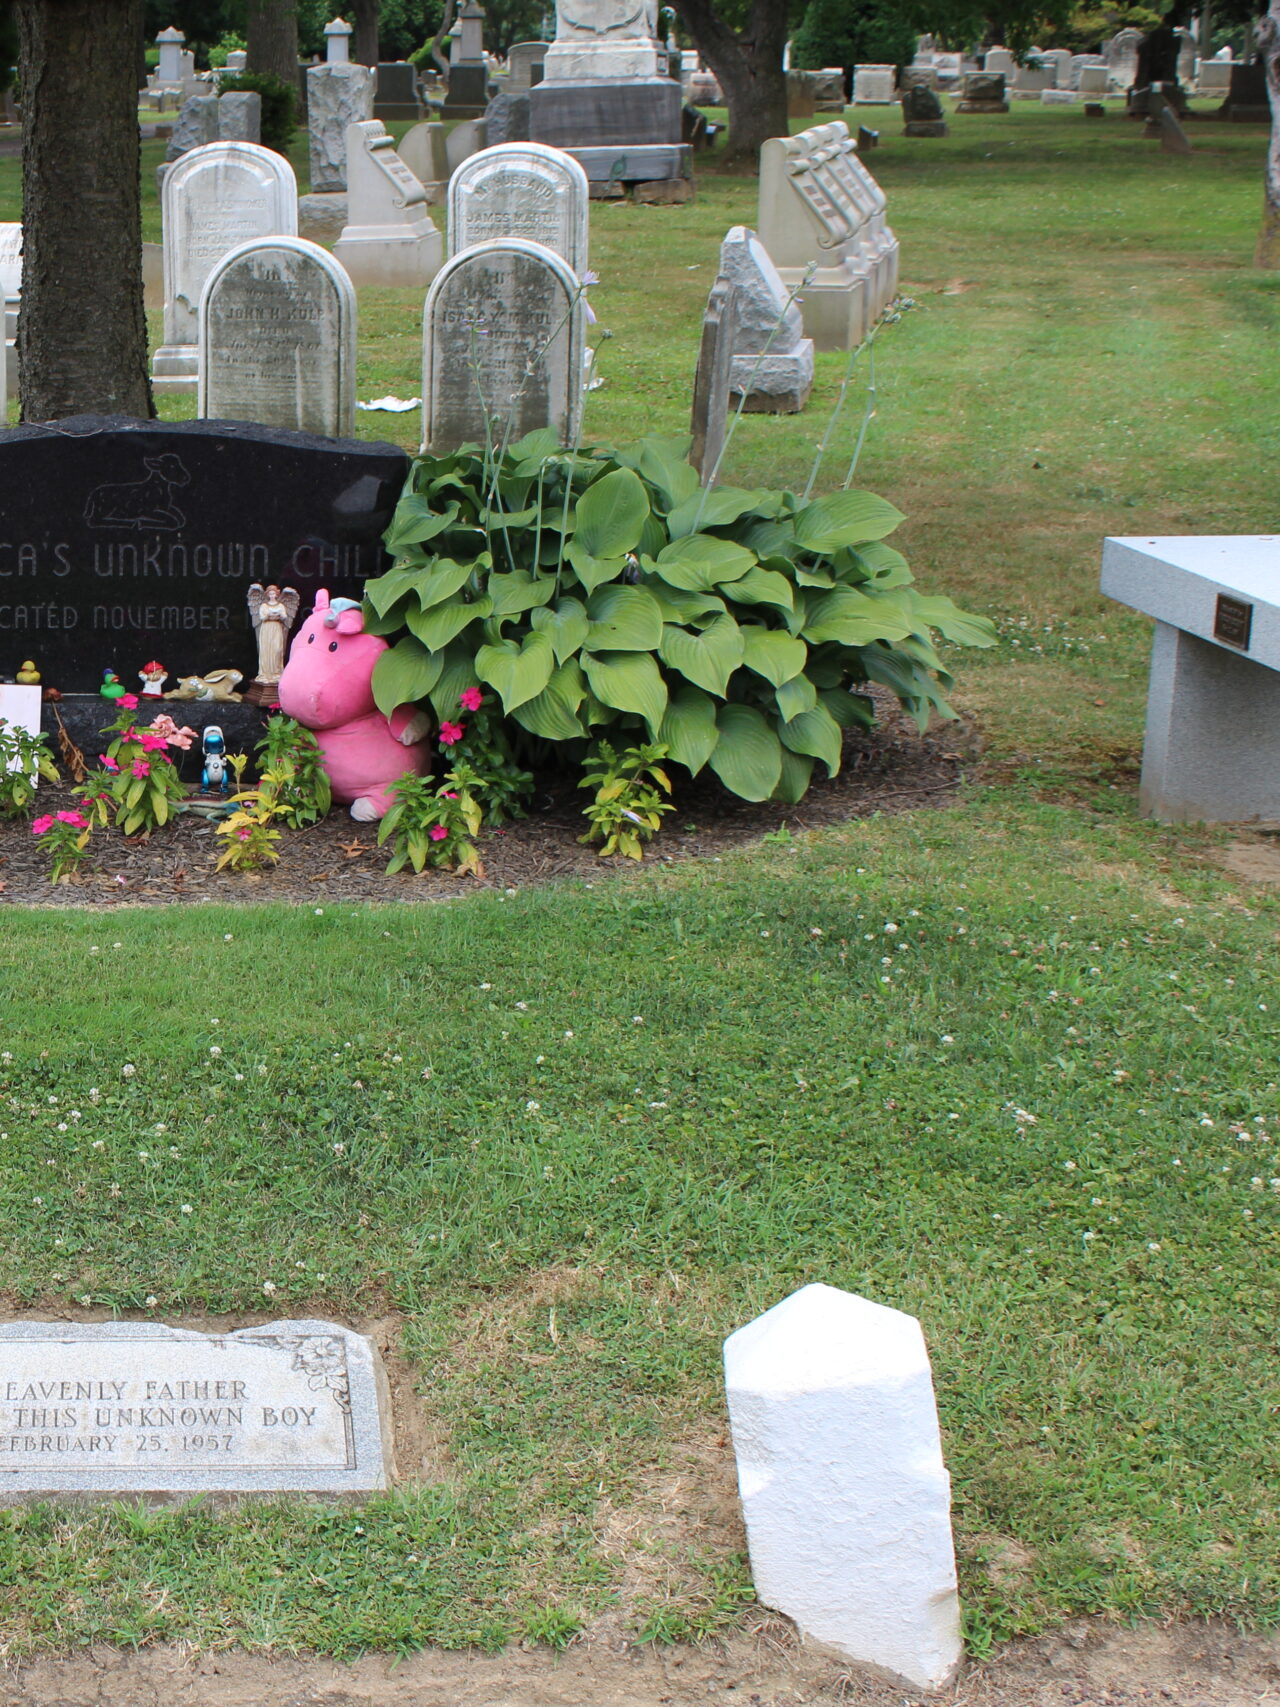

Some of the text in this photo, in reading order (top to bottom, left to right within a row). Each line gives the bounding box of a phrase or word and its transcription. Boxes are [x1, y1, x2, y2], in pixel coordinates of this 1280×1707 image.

[494, 175, 553, 199] HUSBAND
[466, 211, 560, 223] JAMES MARTIN
[225, 307, 264, 320] JOHN
[93, 543, 270, 578] UNKNOWN
[93, 605, 231, 630] NOVEMBER
[144, 1380, 250, 1400] FATHER
[13, 1407, 78, 1429] THIS
[95, 1406, 244, 1428] UNKNOWN
[261, 1405, 318, 1427] BOY
[181, 1434, 234, 1452] 1957
